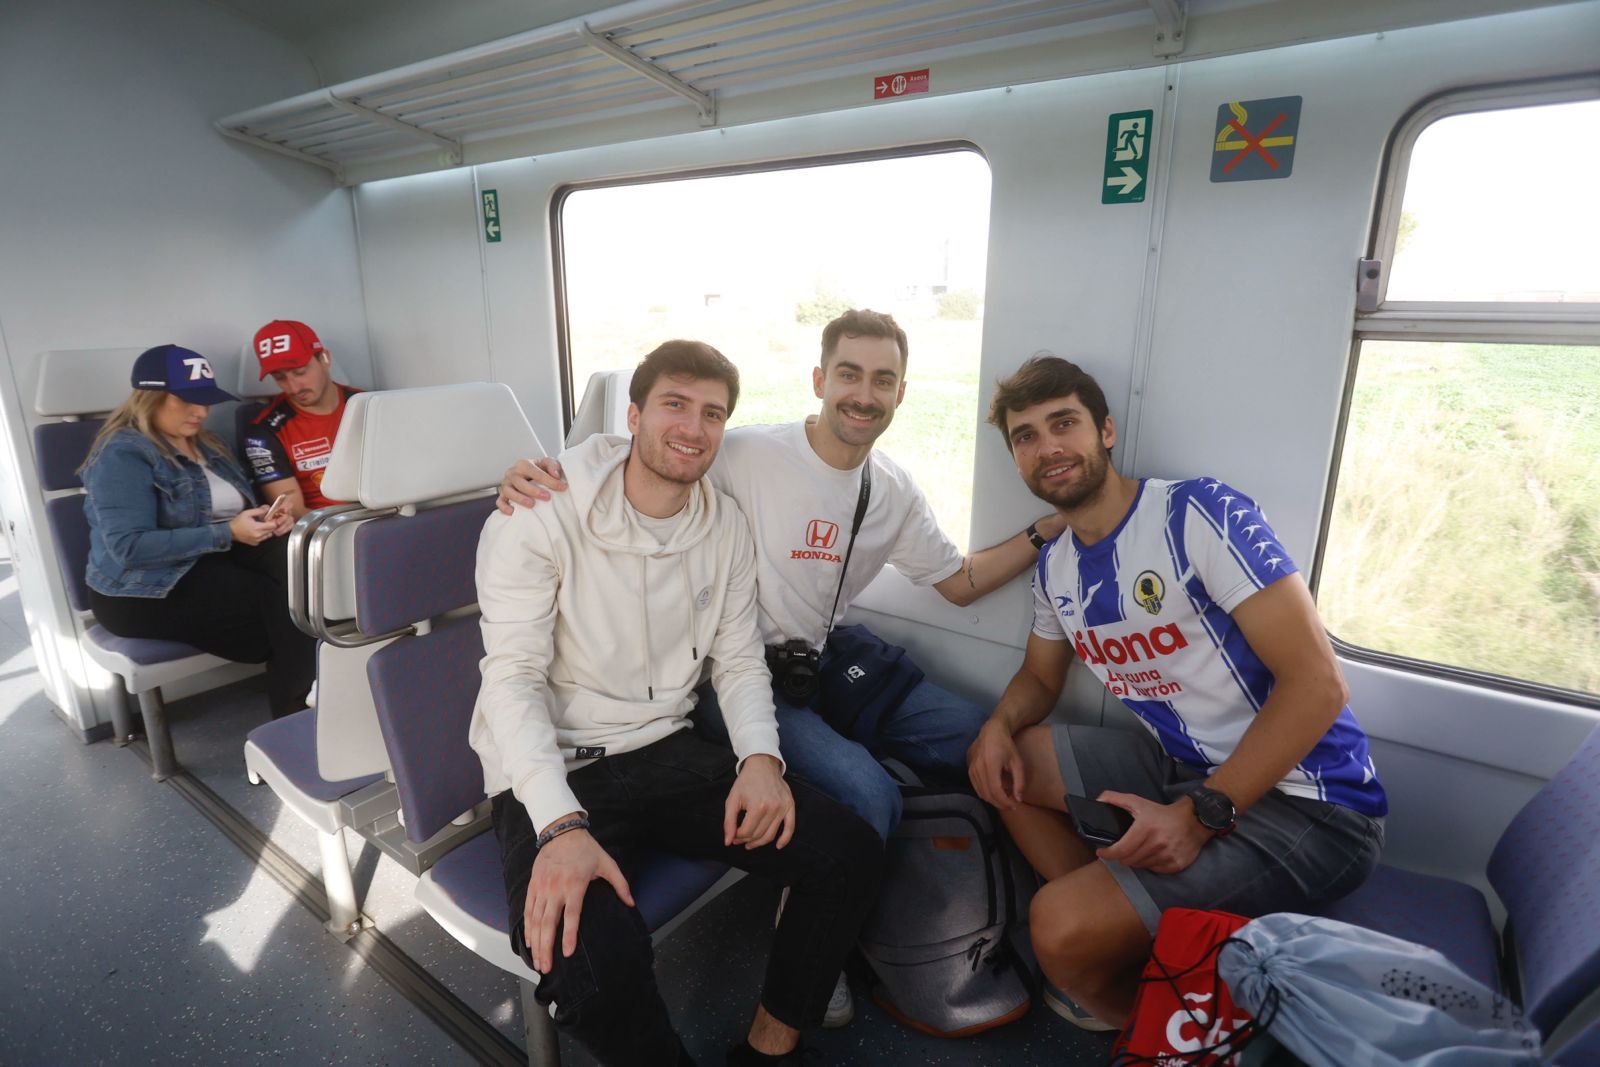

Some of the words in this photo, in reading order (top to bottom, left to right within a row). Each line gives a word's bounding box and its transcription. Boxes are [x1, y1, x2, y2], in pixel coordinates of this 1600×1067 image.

[259, 334, 291, 359] 93
[183, 357, 215, 381] 73
[791, 550, 842, 563] HONDA
[1125, 669, 1162, 683] cuna
